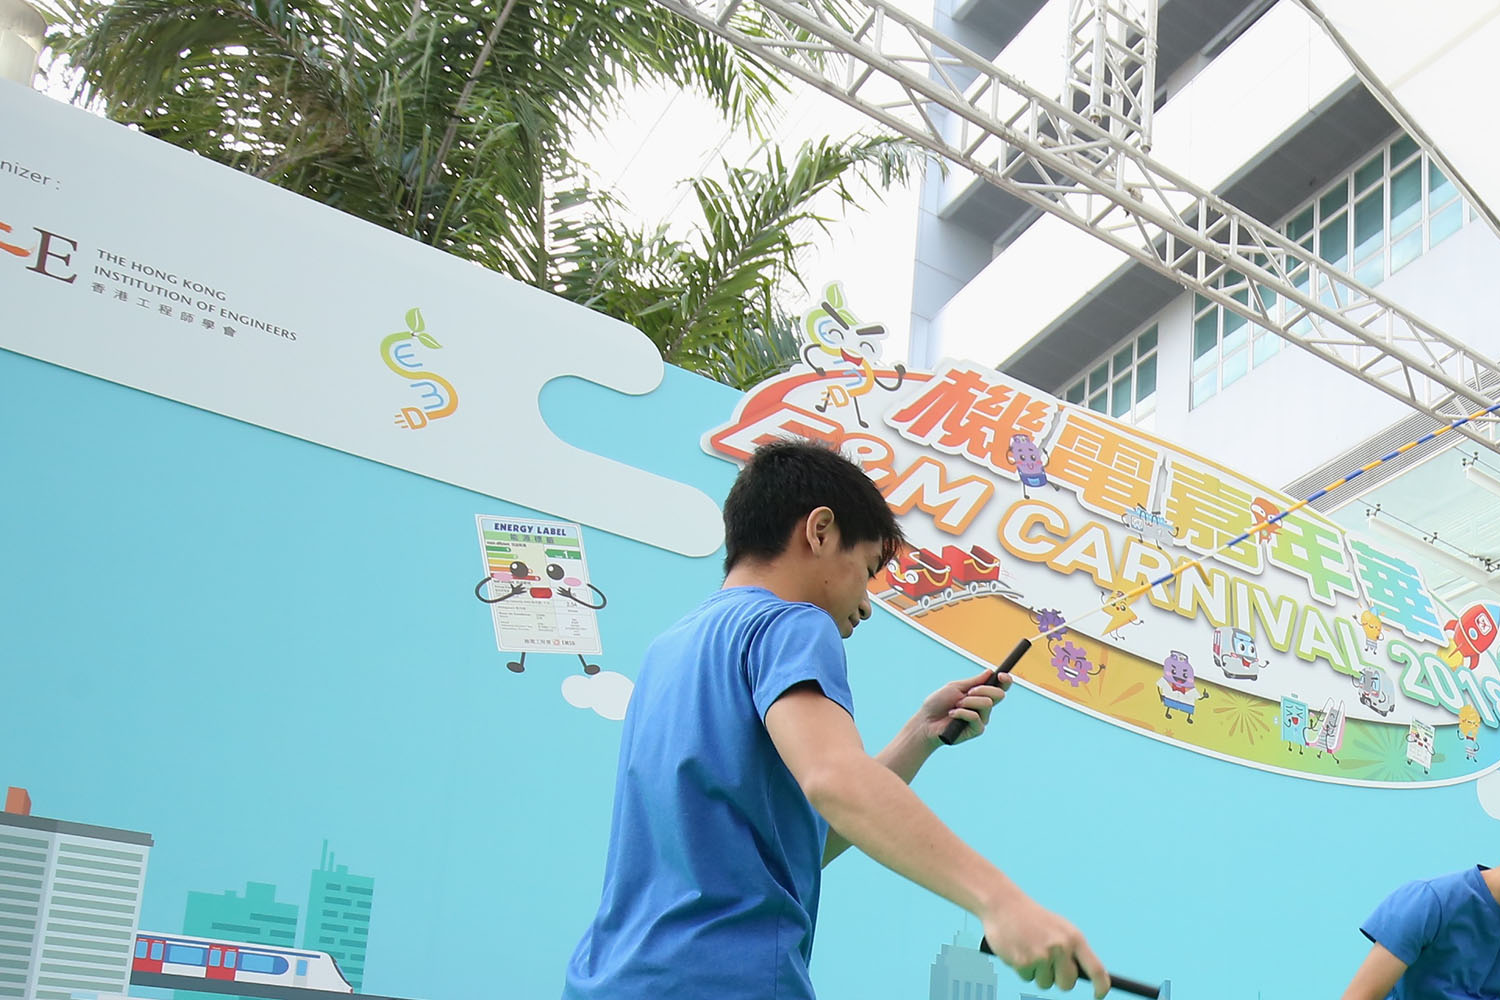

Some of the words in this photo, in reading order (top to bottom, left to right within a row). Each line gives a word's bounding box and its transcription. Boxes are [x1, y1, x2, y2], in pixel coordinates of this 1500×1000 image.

[94, 265, 192, 305] INSTITUTION
[196, 300, 216, 313] OF
[219, 307, 297, 341] ENGINEERS
[97, 249, 127, 267] THE
[131, 261, 178, 285] HONG
[183, 279, 227, 301] KONG
[91, 282, 237, 338] 香港工程師學會
[494, 523, 533, 533] ENERGY
[537, 527, 566, 536] LABEL
[890, 366, 1446, 645] 機電嘉年華
[1001, 501, 1384, 676] CARNIVAL
